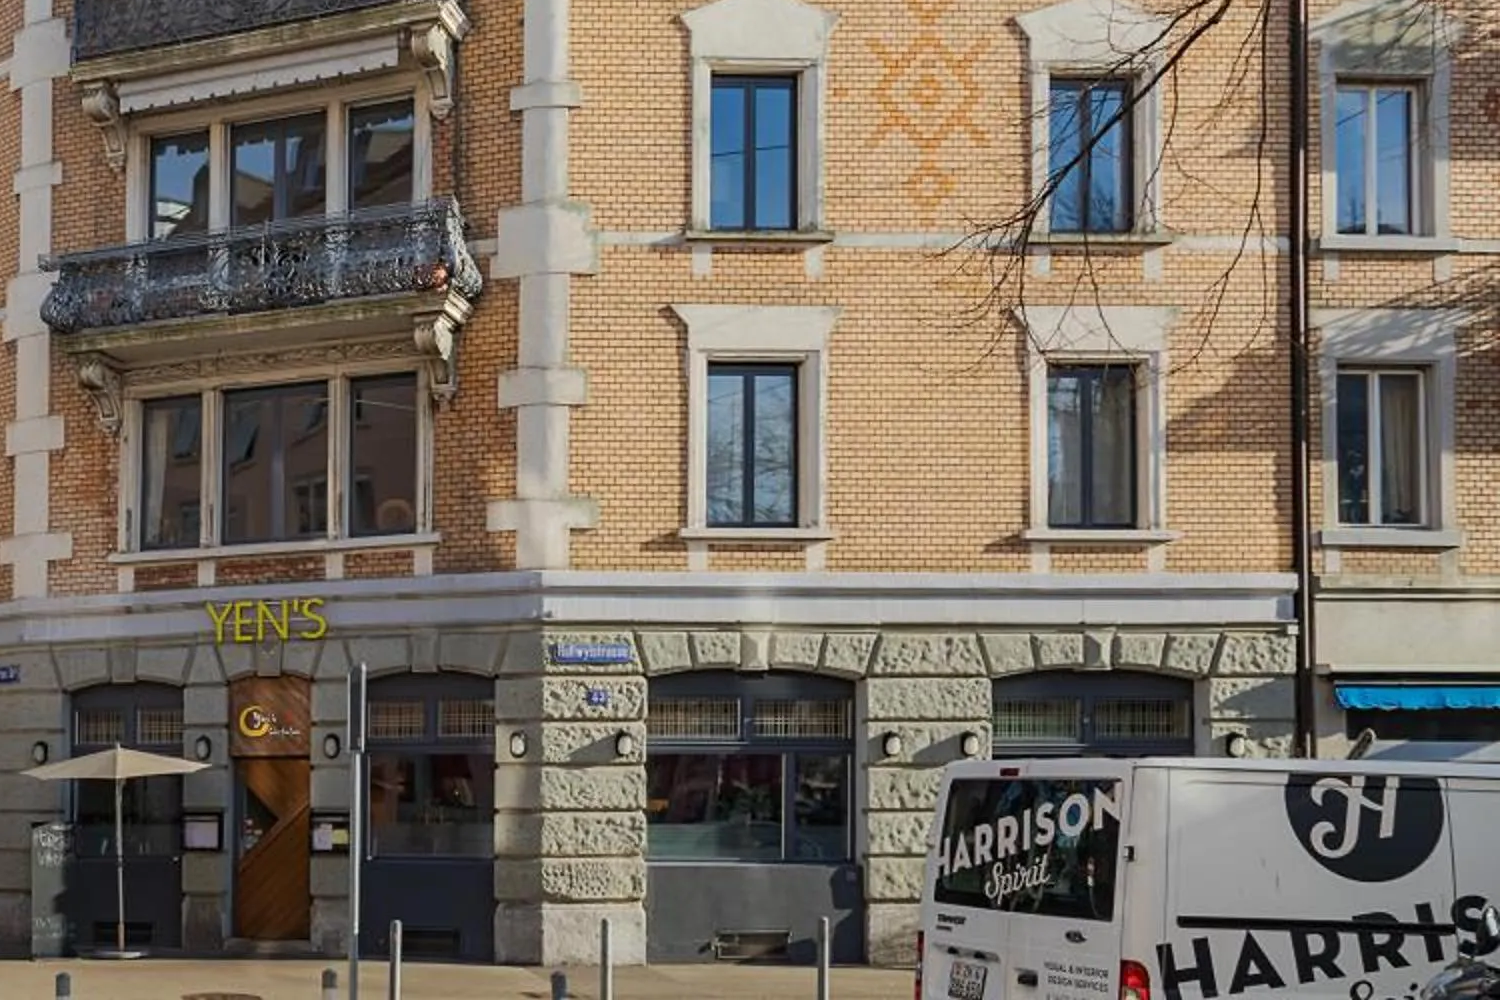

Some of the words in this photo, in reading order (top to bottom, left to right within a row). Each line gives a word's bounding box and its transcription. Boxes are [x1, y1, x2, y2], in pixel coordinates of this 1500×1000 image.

[205, 597, 328, 645] YEN'S
[935, 781, 1123, 877] HARRISON
[984, 852, 1052, 906] Spirit
